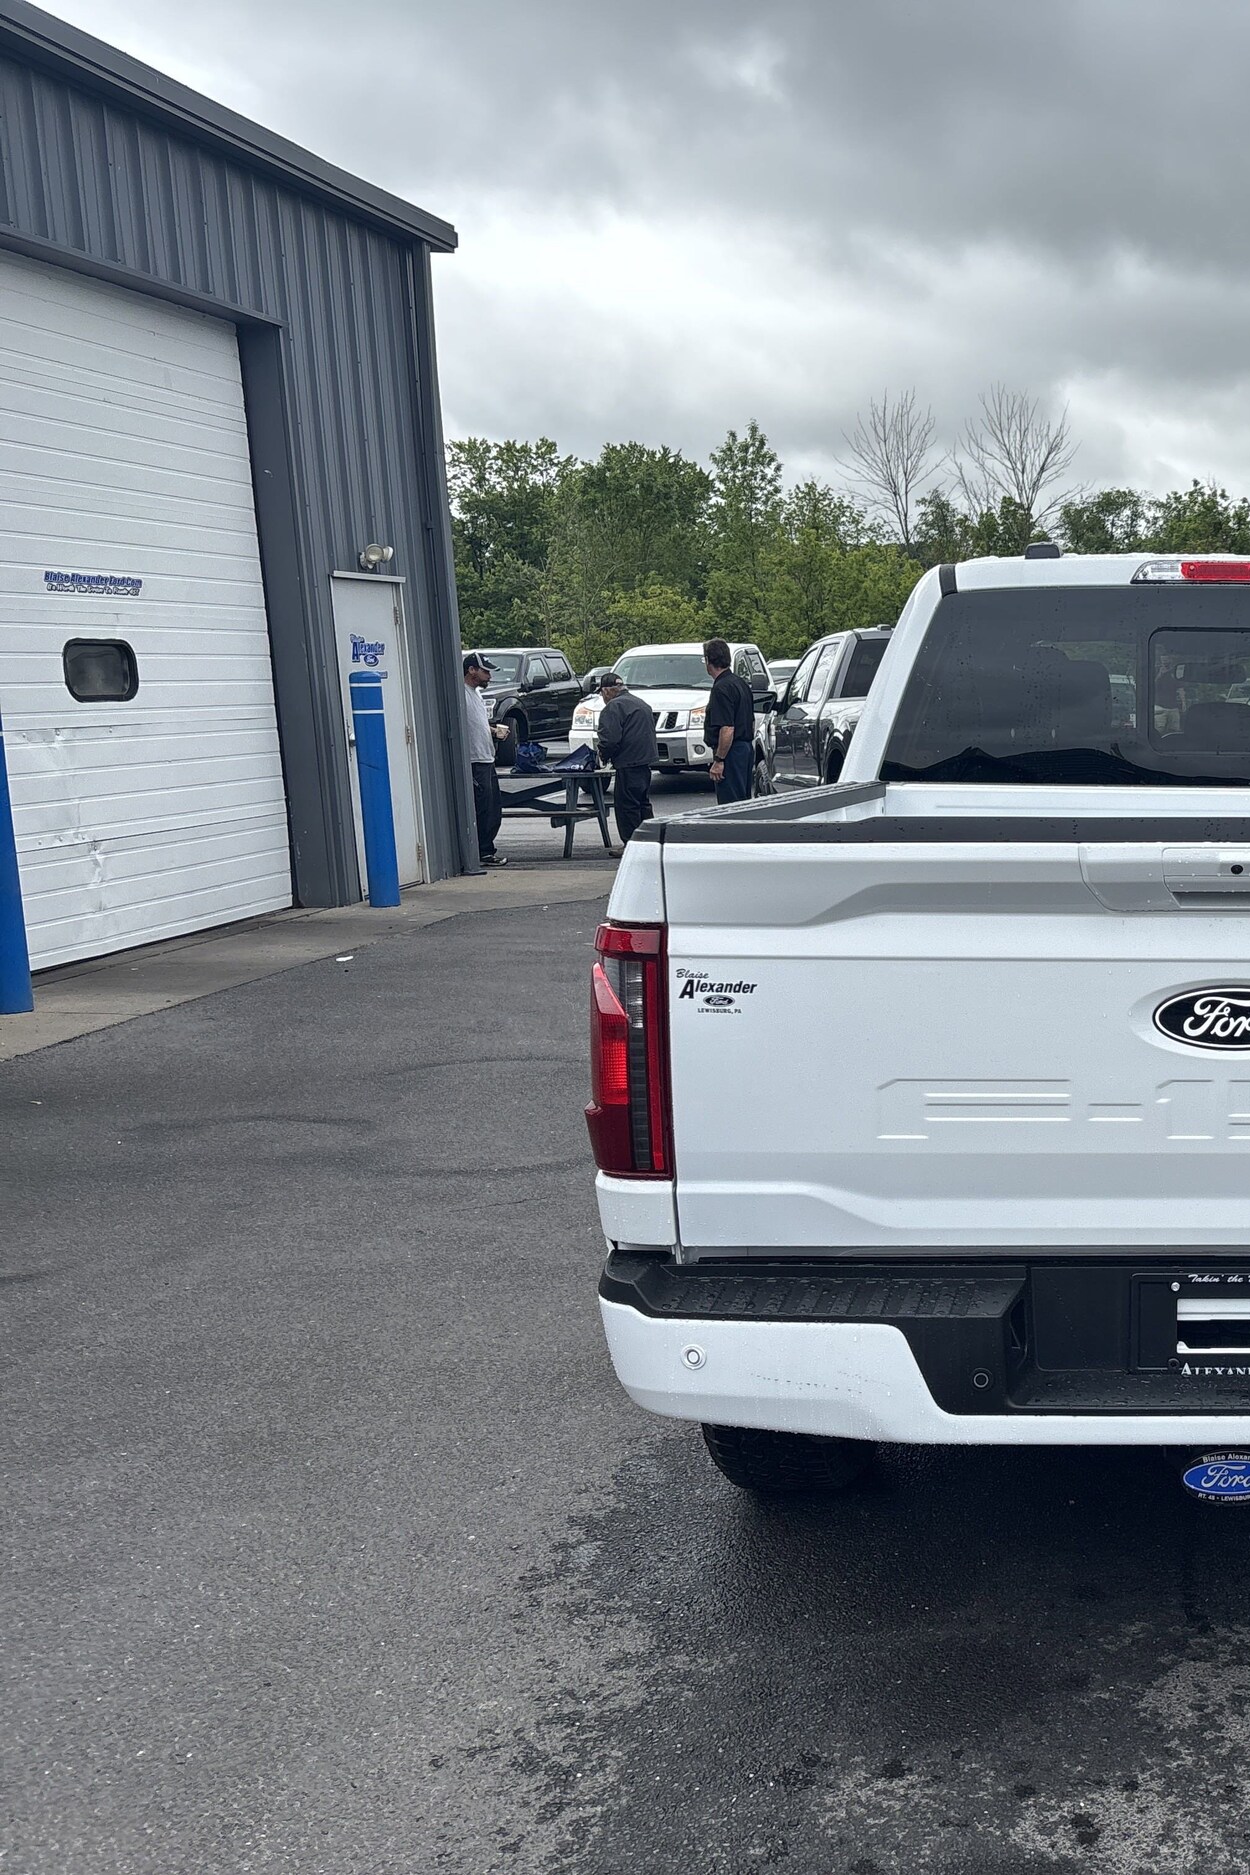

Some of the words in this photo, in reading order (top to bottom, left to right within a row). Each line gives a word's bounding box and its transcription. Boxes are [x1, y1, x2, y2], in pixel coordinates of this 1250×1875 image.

[676, 968, 710, 979] Blaise
[678, 979, 758, 999] Alexander
[709, 996, 729, 1005] Ford
[1188, 1273, 1225, 1283] Takin'
[1227, 1274, 1243, 1283] the
[1202, 1455, 1226, 1464] Blaise
